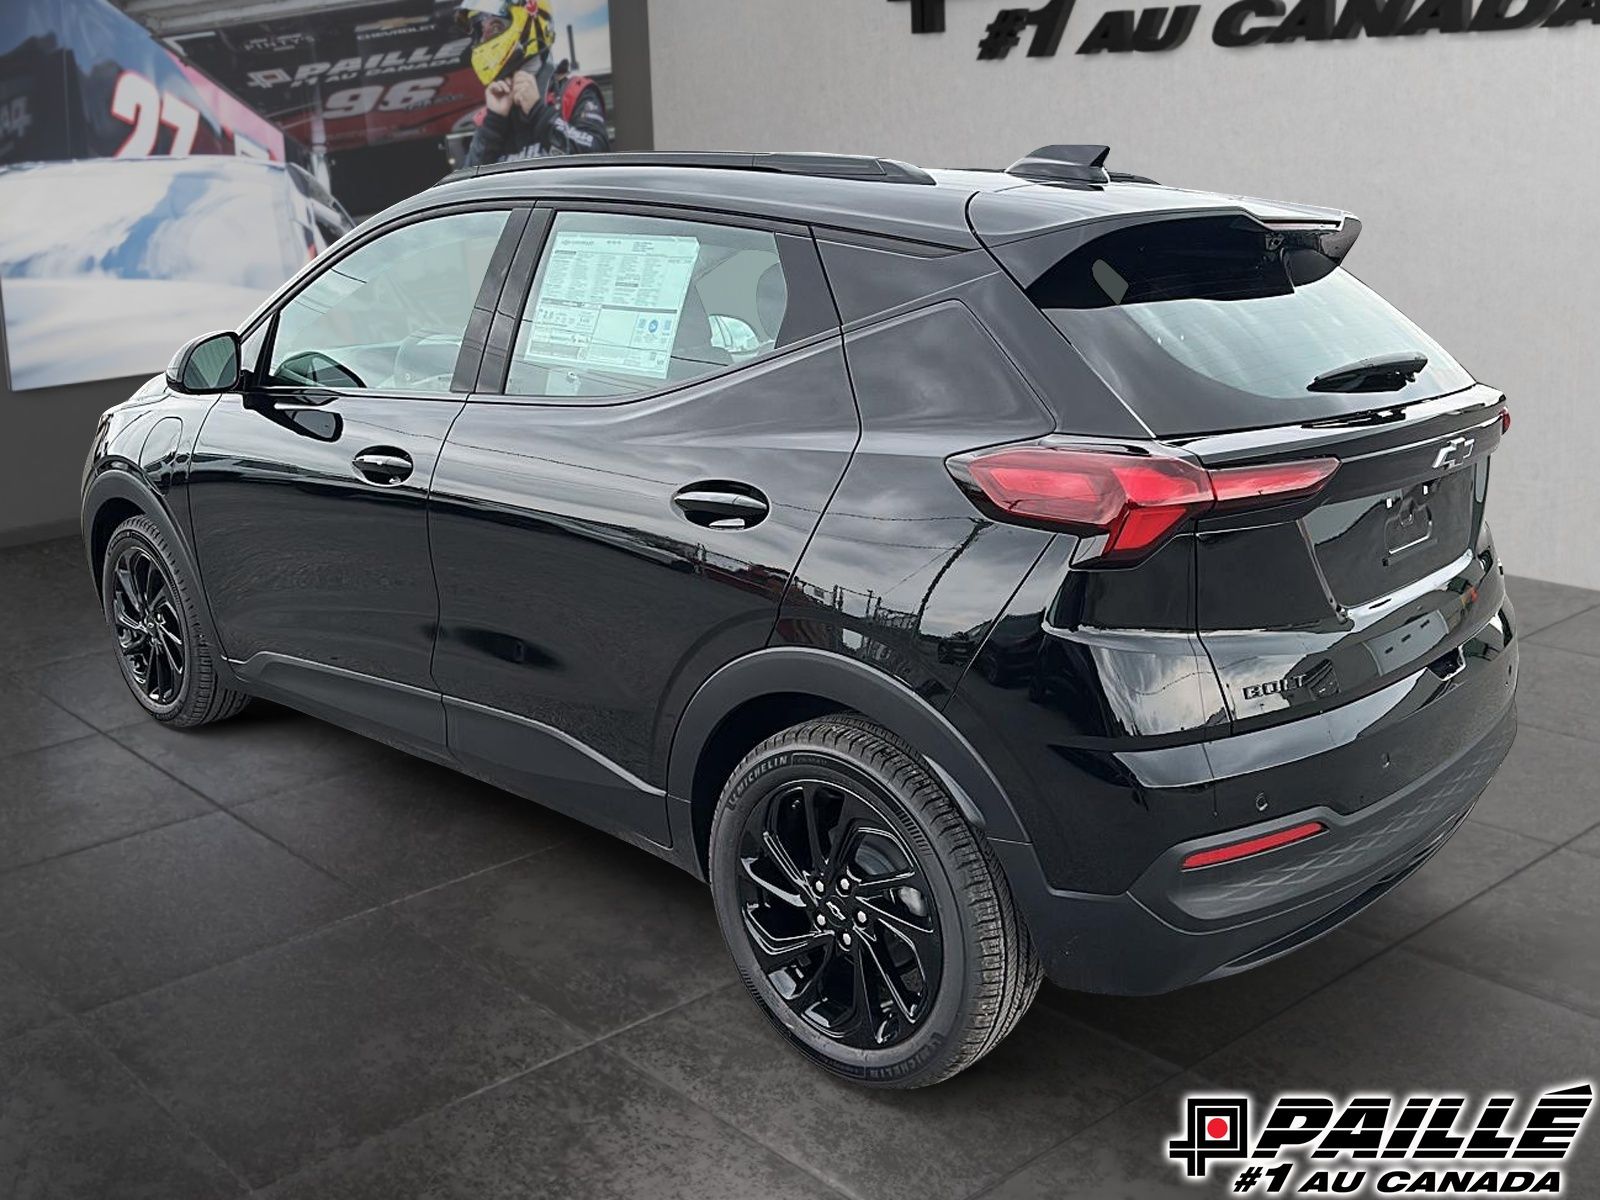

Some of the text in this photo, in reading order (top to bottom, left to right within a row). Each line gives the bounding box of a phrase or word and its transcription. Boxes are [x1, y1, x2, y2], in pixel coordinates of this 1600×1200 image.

[976, 0, 1076, 60] #1
[1074, 5, 1201, 54] AU
[365, 57, 461, 76] CANADA
[111, 71, 199, 157] 27
[321, 76, 445, 119] 96
[1242, 673, 1307, 701] BOLT
[735, 755, 788, 797] MICHELIN
